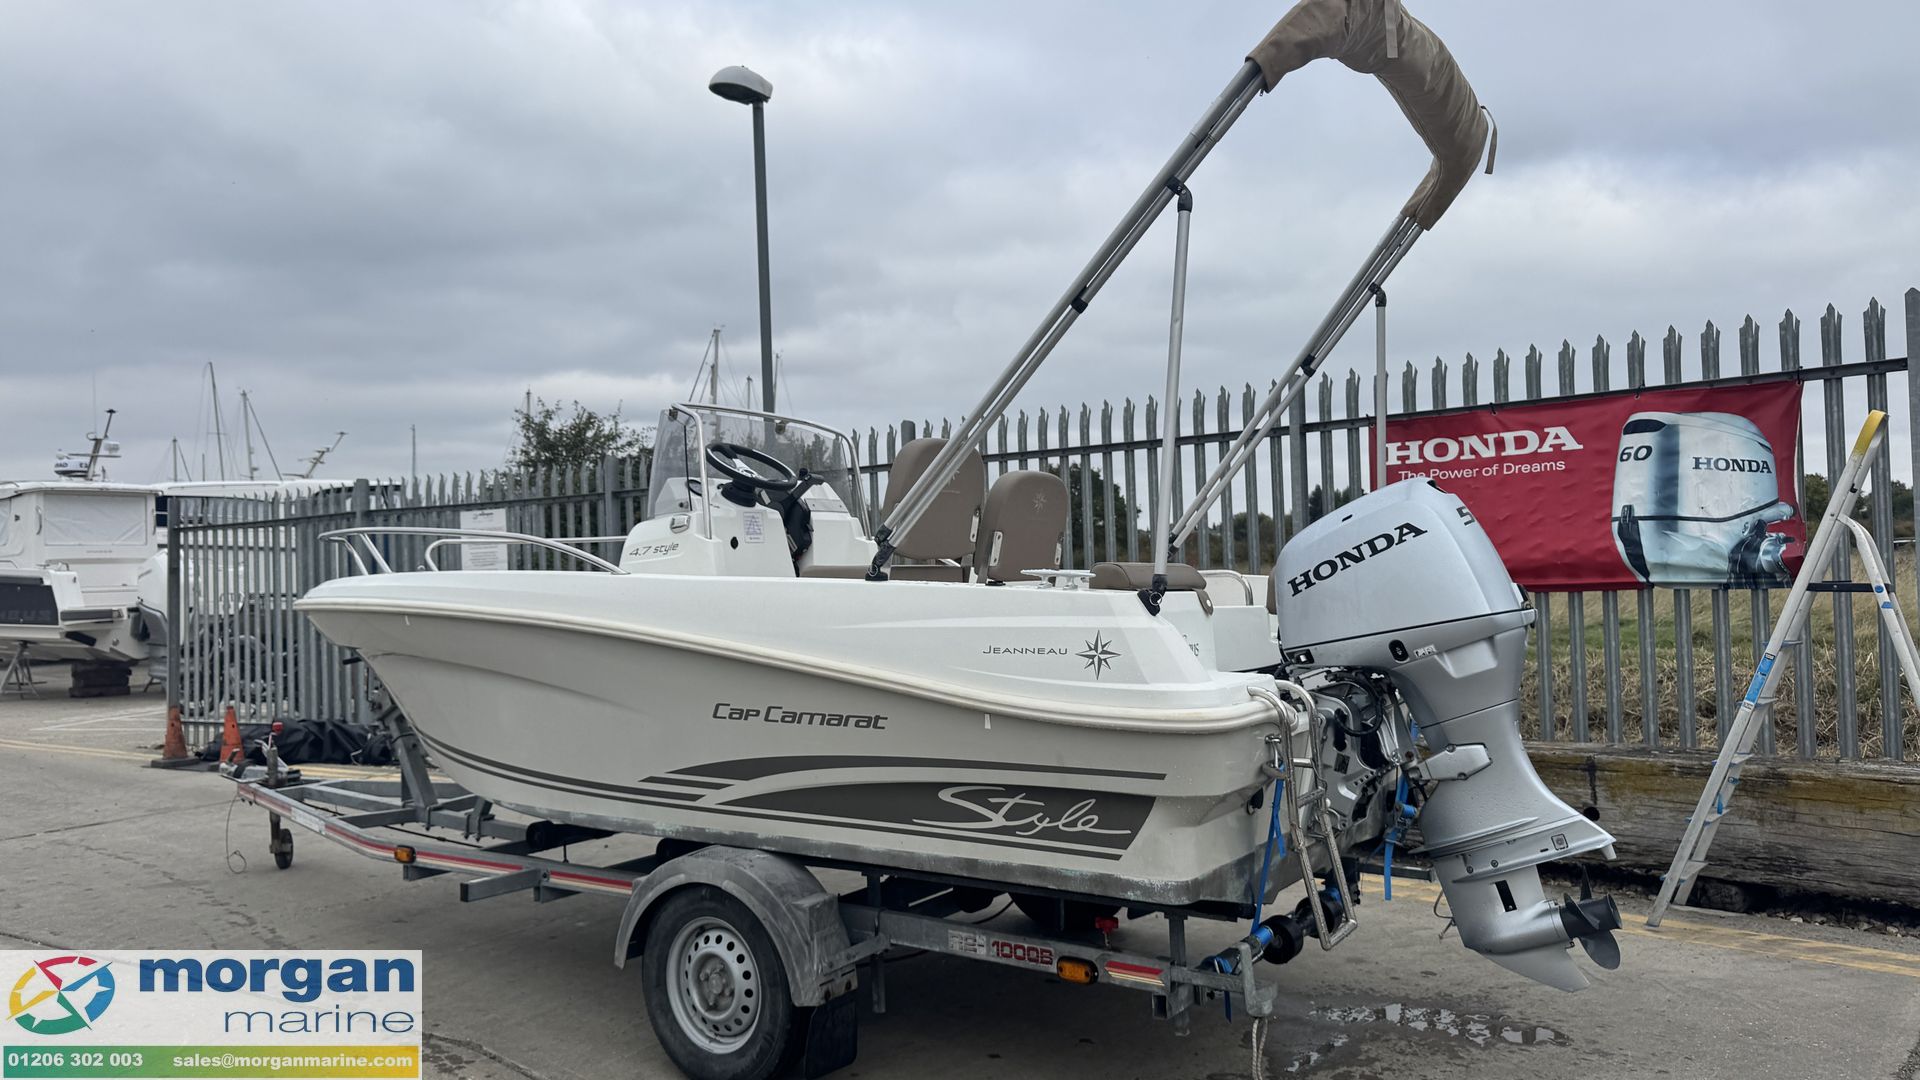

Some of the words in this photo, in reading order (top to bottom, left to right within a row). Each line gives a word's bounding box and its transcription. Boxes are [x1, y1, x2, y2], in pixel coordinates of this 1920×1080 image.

[1386, 426, 1584, 466] HONDA
[1619, 445, 1653, 463] 60
[1430, 466, 1479, 480] Power
[1482, 463, 1500, 476] of
[1503, 460, 1566, 475] Dreams
[1692, 456, 1773, 474] HONDA
[629, 546, 652, 556] 4.7
[653, 542, 679, 556] style
[1287, 522, 1428, 597] HONDA
[982, 645, 1068, 655] JEANNEAU
[764, 705, 888, 730] Camarat
[912, 785, 1132, 836] Style
